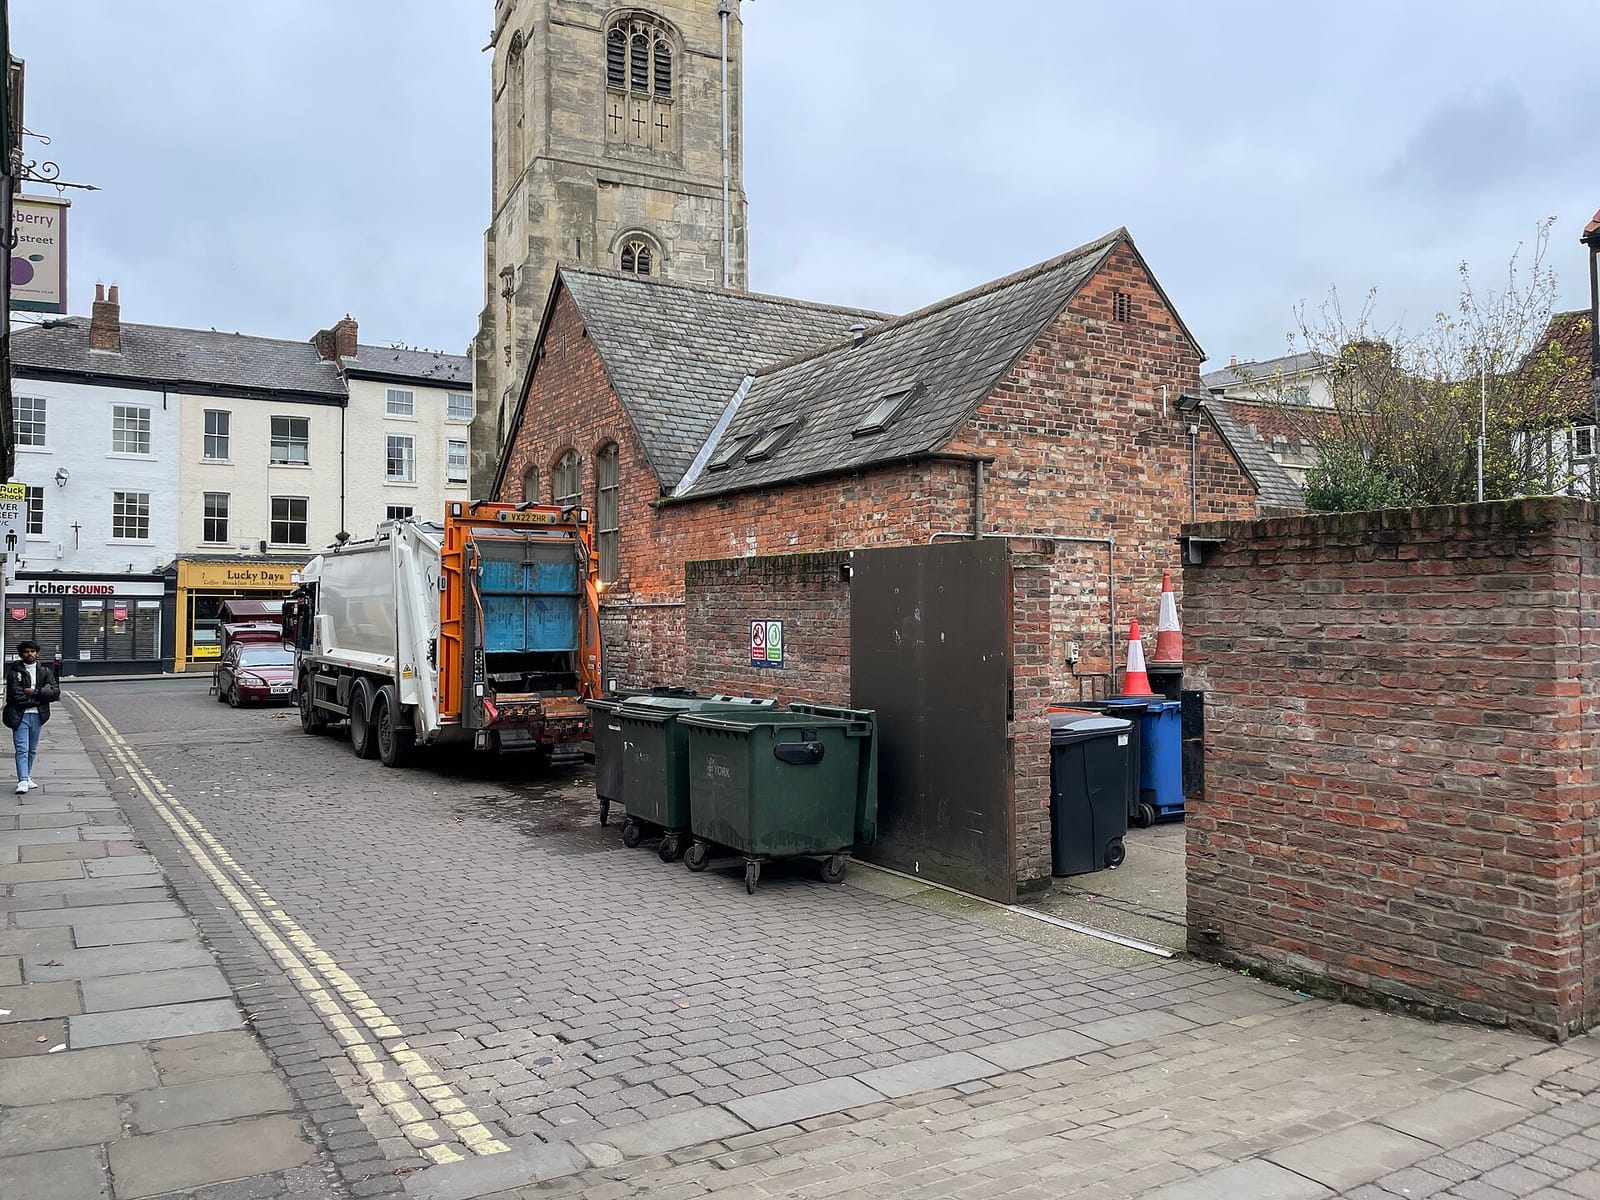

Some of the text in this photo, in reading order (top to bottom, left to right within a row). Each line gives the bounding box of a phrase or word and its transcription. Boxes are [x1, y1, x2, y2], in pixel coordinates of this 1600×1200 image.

[20, 235, 54, 244] street
[511, 513, 546, 522] VX22 ZHR
[227, 570, 285, 581] Lucky Days
[28, 581, 114, 594] richer SOUNDS
